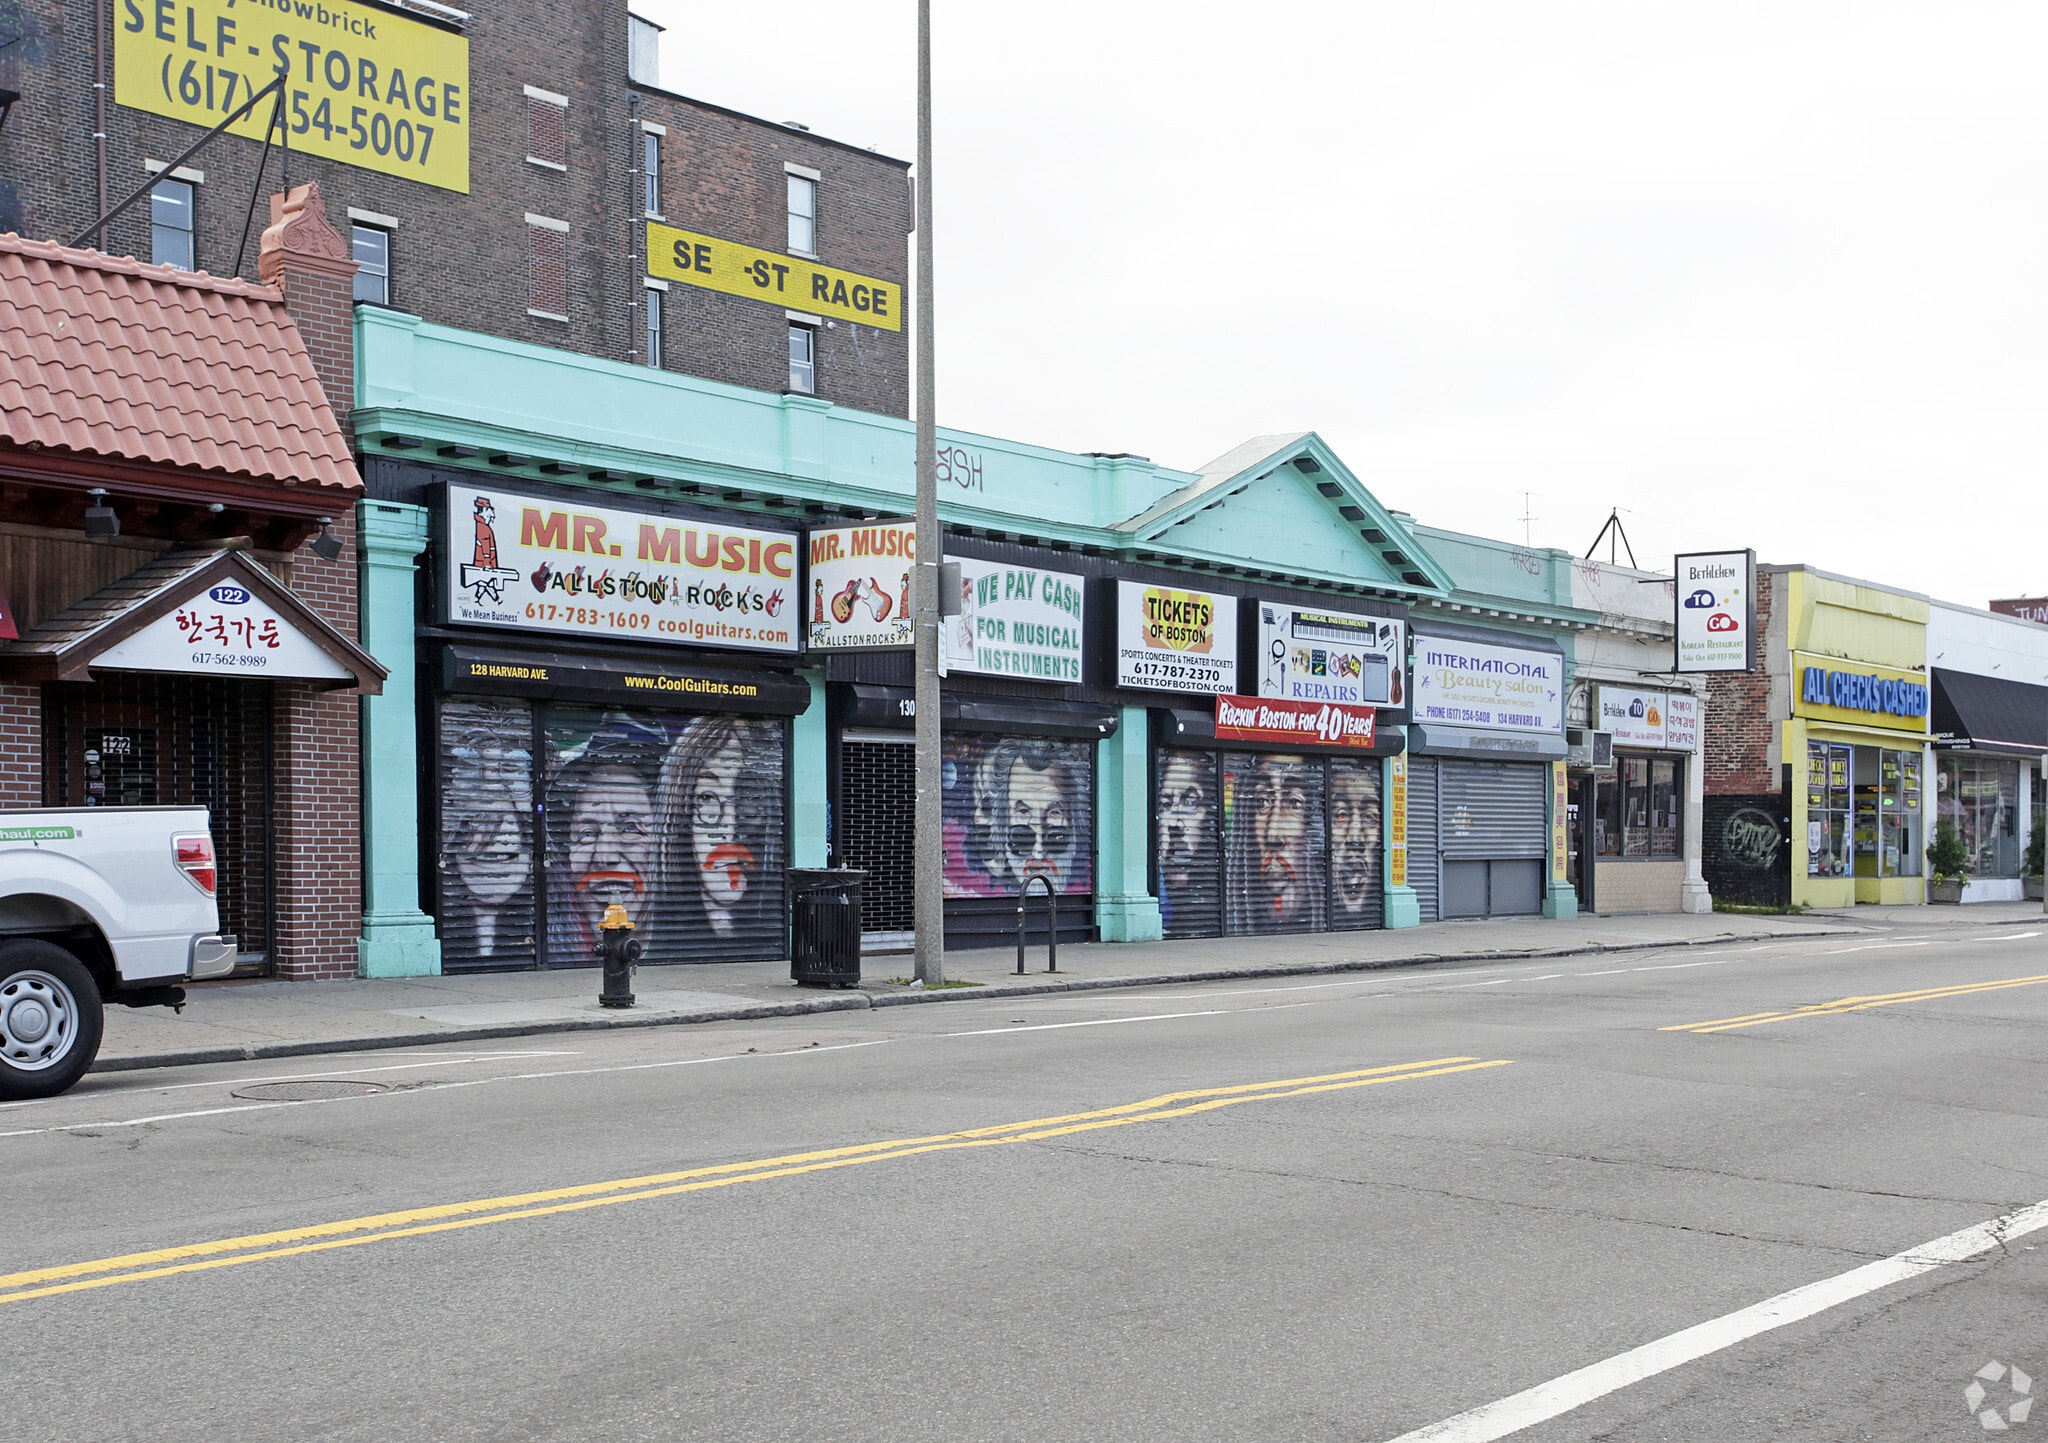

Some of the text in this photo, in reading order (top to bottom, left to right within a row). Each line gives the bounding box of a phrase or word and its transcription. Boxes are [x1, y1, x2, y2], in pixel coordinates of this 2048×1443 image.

[162, 53, 253, 122] (617)
[812, 273, 888, 317] RAGE
[520, 507, 794, 579] MR. MUSIC
[810, 534, 844, 566] MR.
[216, 587, 243, 603] 122
[551, 571, 764, 611] ALLSTON ROCKS
[977, 570, 1081, 622] WE PAY CASH
[1693, 593, 1712, 606] TO
[474, 609, 490, 620] Mean
[1148, 598, 1209, 626] TICKETS
[1300, 613, 1369, 628] MUSICAL INSTRUMENTS
[175, 609, 280, 649] 한국가든
[525, 603, 788, 643] 617-783-1609 coolguitars.com
[1709, 616, 1731, 630] GO
[826, 633, 895, 647] ALLSTON ROCKS
[977, 617, 1079, 651] FOR MUSICAL
[1150, 625, 1206, 644] OF BOSTON
[192, 652, 267, 668] 617-562-8989
[977, 649, 1079, 678] INSTRUMENTS
[1121, 649, 1143, 660] SPORTS
[1144, 650, 1176, 663] CONCERTS
[1183, 655, 1209, 667] THEATER
[1210, 657, 1233, 668] TICKETS
[1427, 652, 1549, 679] INTERNATIONAL
[470, 664, 549, 680] 128 HARVARD AVE.
[1134, 662, 1220, 682] 617-787-2370
[624, 675, 757, 696] www.CoolGuitars.com
[1121, 675, 1233, 693] TICKETSOFBOSTON.COM
[1292, 682, 1357, 701] REPAIRS
[1435, 669, 1543, 696] Beauty salon
[1804, 667, 1830, 704] ALL
[900, 700, 915, 716] 130
[1427, 706, 1445, 719] PHONE
[1446, 708, 1460, 720] (617)
[1498, 713, 1507, 724] 134
[1508, 714, 1533, 726] HARVARD
[1633, 703, 1642, 715] TO
[1648, 711, 1658, 722] GO
[1259, 706, 1296, 730] BOSTON
[1299, 713, 1316, 731] FOR
[1316, 704, 1341, 741] 40
[1342, 712, 1373, 737] YEARS!
[104, 737, 130, 754] 122
[0, 829, 68, 839] haul.com
